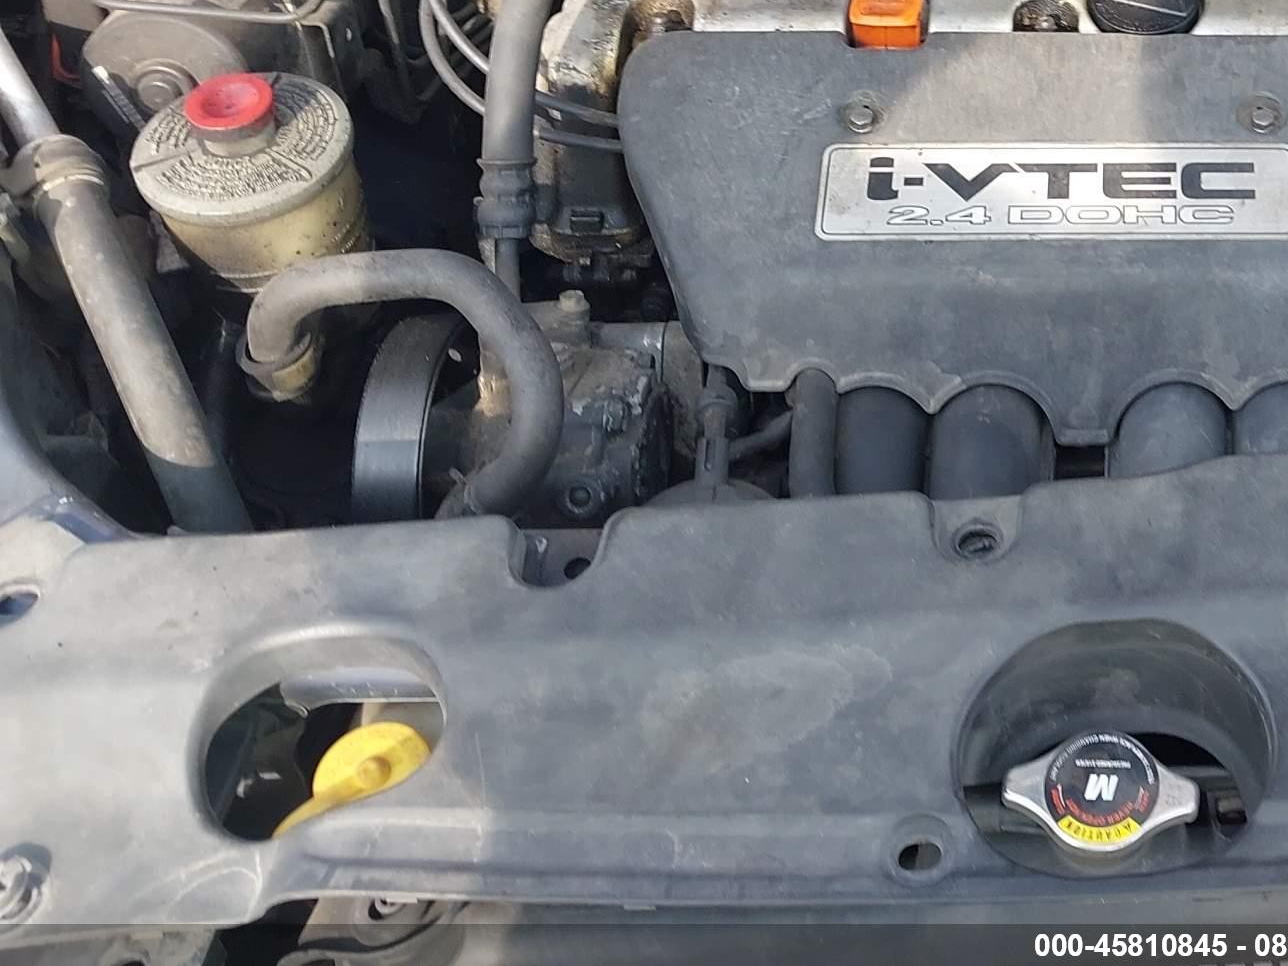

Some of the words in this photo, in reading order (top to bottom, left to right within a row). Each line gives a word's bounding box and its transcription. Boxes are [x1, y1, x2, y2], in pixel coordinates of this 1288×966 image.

[866, 156, 1256, 201] i-VTEC
[886, 205, 992, 226] 2.4
[1007, 205, 1235, 226] DOHC
